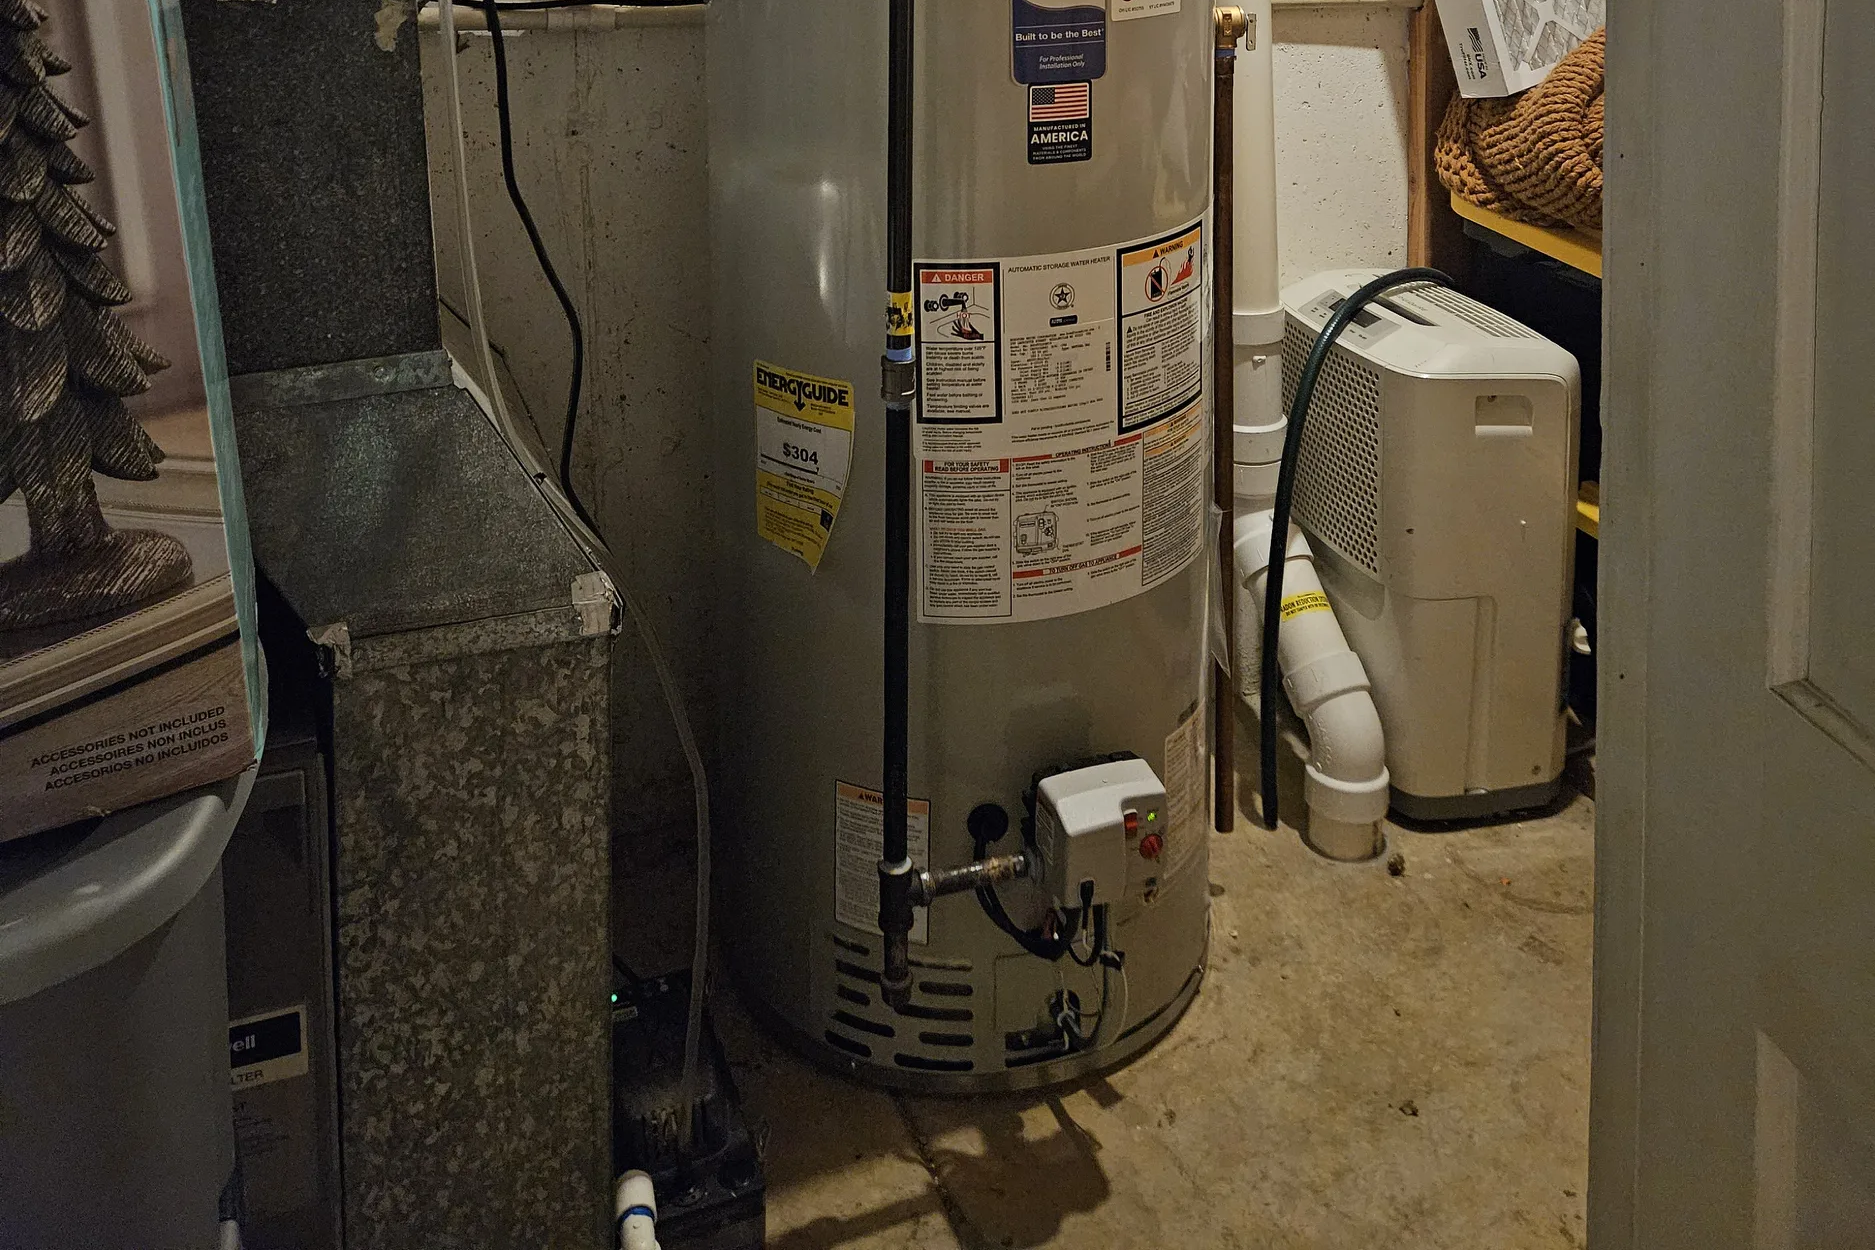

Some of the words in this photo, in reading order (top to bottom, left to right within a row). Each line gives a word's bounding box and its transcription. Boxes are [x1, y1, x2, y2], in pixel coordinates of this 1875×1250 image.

[1015, 32, 1036, 41] Built
[1038, 32, 1048, 40] to
[1051, 32, 1062, 40] be
[1065, 30, 1079, 38] the
[1039, 61, 1072, 70] Installation
[1072, 60, 1085, 68] Only
[1050, 54, 1084, 62] Professional
[1475, 54, 1487, 79] USA
[1034, 124, 1078, 132] MANUFACTURED
[1030, 130, 1089, 144] AMERICA
[1160, 240, 1184, 255] WARNING
[1008, 265, 1042, 273] AUTOMATIC
[1043, 262, 1070, 270] STORAGE
[1090, 256, 1110, 264] HEATER
[944, 274, 984, 282] DANGER
[756, 367, 849, 407] ENERGYGUIDE
[782, 442, 819, 465] $304
[1055, 449, 1081, 458] OPERATING
[30, 734, 125, 769] ACCESSORIES
[129, 726, 156, 741] NOT
[159, 706, 225, 733] INCLUDED
[50, 743, 143, 776] ACCESSOIRES
[147, 734, 175, 750] NON
[179, 719, 227, 741] INCLUS
[45, 759, 132, 791] ACCESORIOS
[135, 754, 154, 766] NO
[158, 733, 229, 762] INCLUIDOS
[231, 1034, 256, 1052] ell
